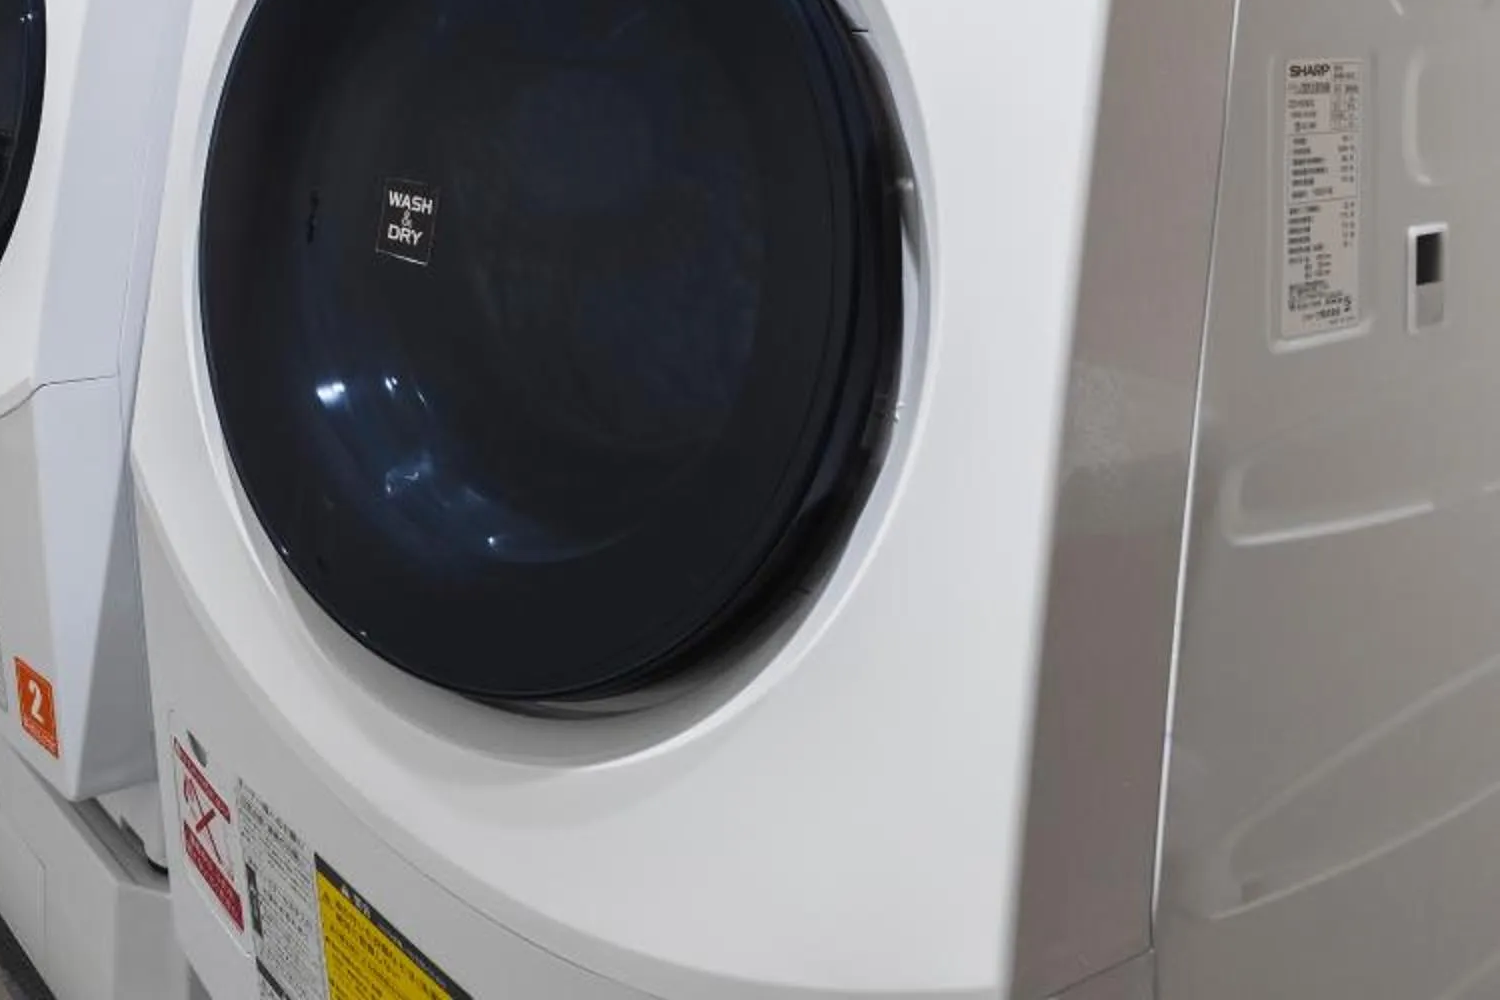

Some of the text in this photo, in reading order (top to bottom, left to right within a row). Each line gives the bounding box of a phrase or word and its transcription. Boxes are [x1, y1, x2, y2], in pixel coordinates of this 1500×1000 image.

[1289, 63, 1331, 78] SHARP
[388, 189, 433, 215] WASH
[401, 209, 413, 229] &
[387, 223, 424, 247] DRY
[27, 679, 46, 726] 2
